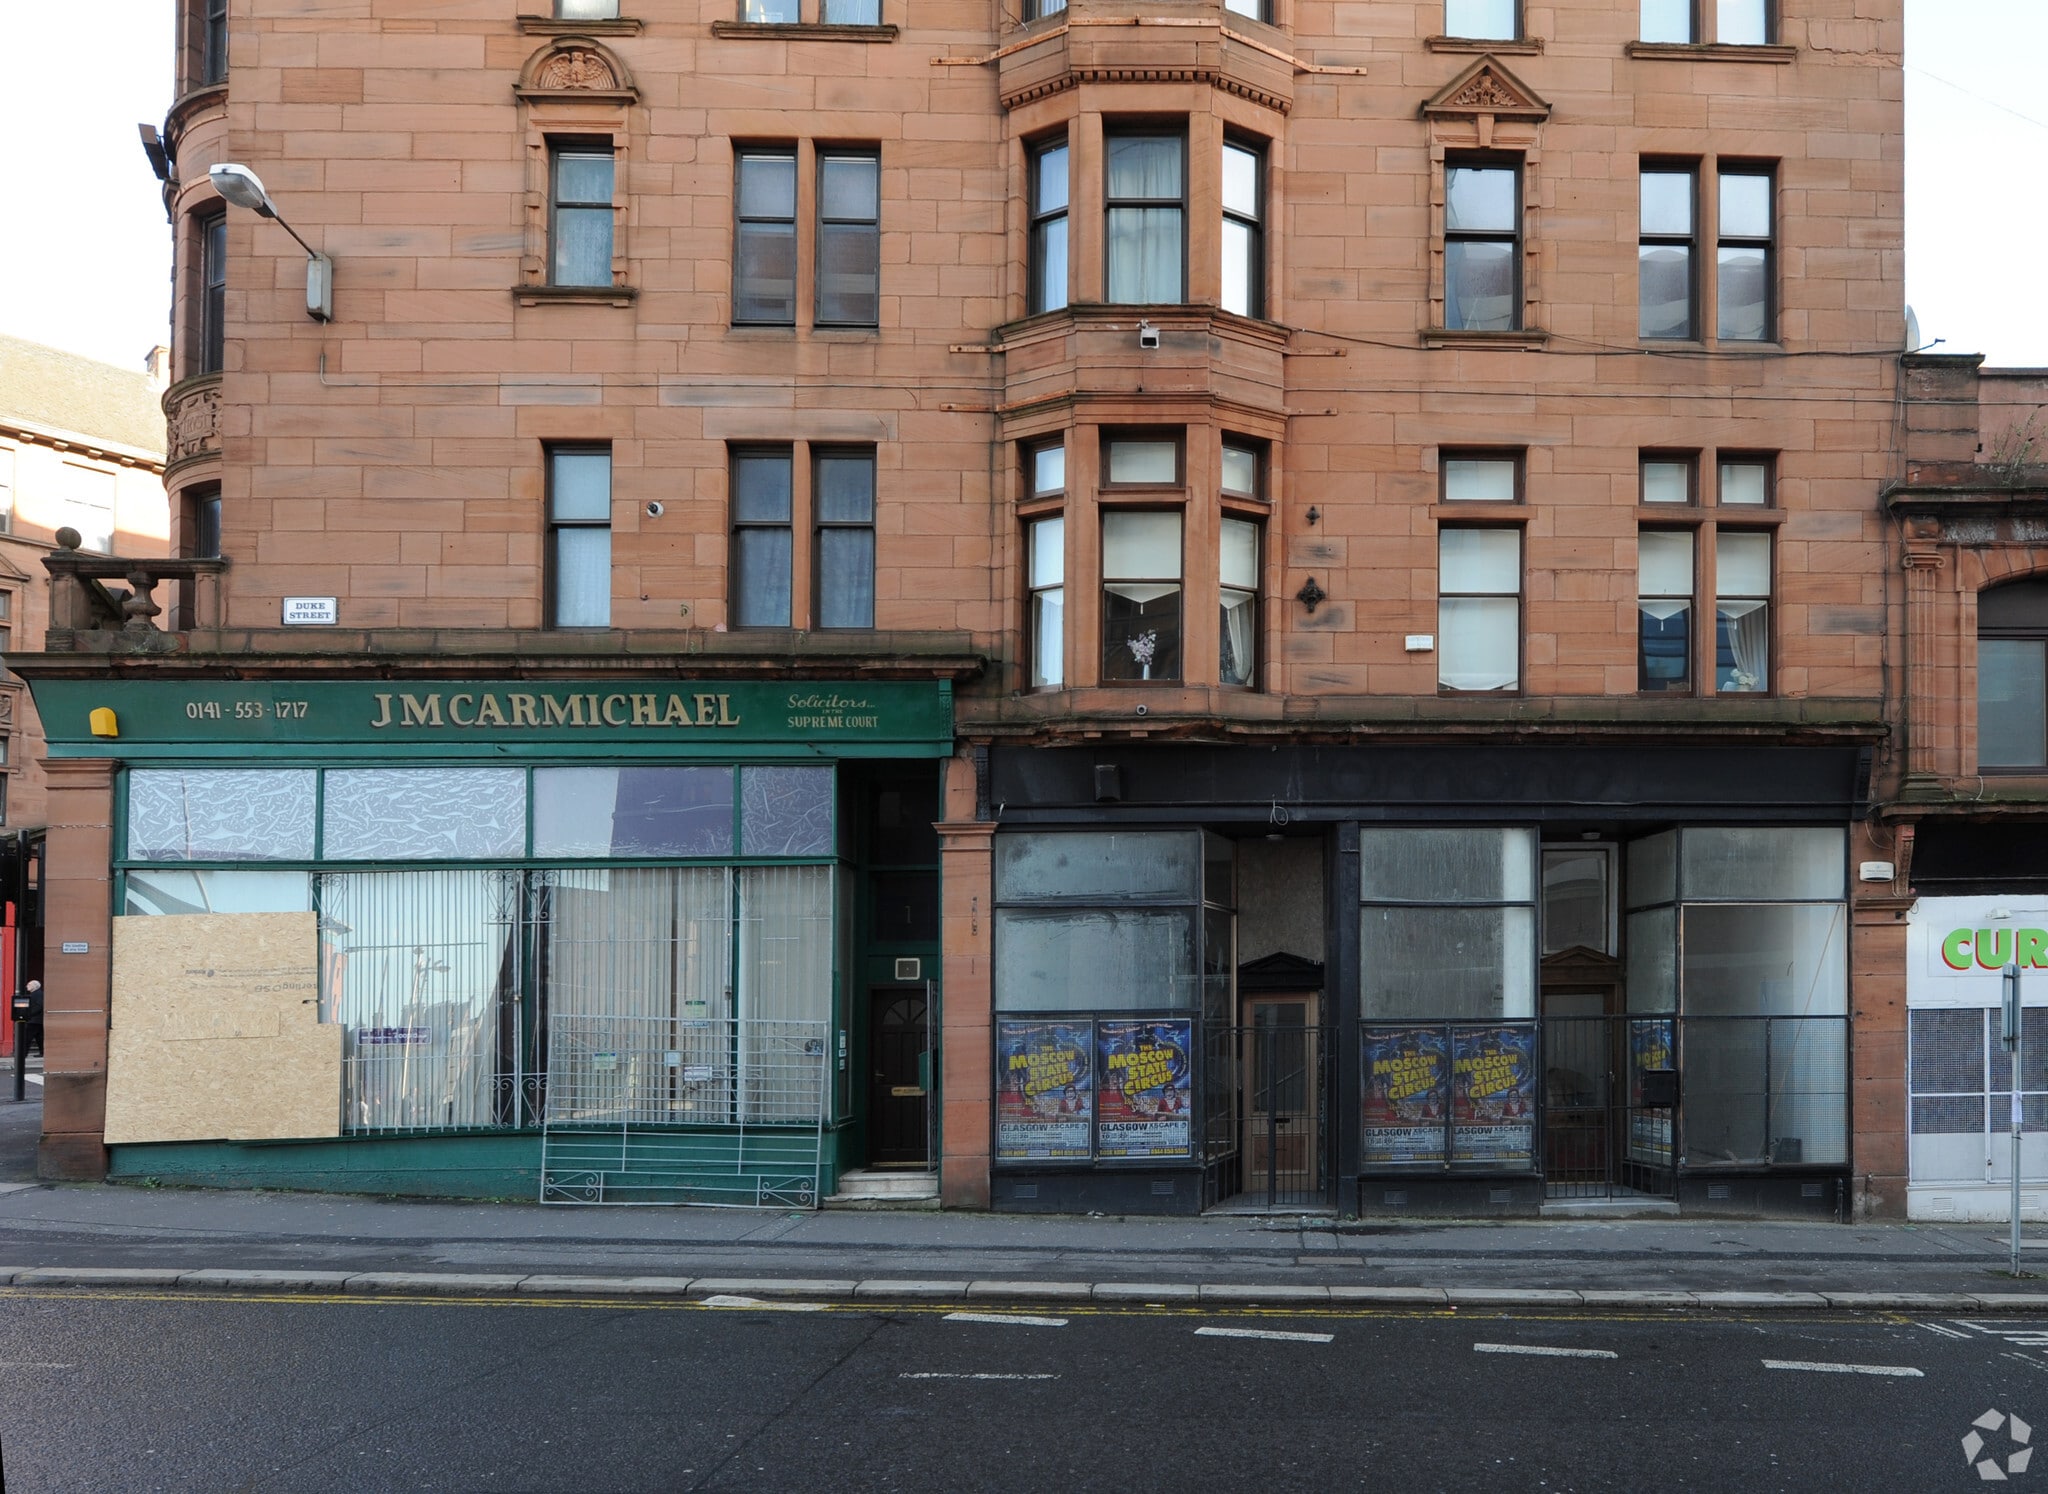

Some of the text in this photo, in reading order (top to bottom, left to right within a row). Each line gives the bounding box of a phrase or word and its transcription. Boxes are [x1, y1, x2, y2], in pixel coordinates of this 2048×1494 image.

[186, 702, 221, 718] 0141
[235, 702, 263, 718] 553
[275, 702, 308, 718] 1717
[787, 716, 878, 728] SUPREME COURT
[1009, 1050, 1075, 1070] MOSCOW
[1108, 1049, 1174, 1069] MOSCOW
[1373, 1055, 1437, 1075] MOSCOW
[1455, 1054, 1517, 1073] MOSCOW
[1030, 1062, 1069, 1080] STATE
[1128, 1061, 1167, 1079] STATE
[1393, 1067, 1430, 1086] STATE
[1474, 1066, 1511, 1084] STATE
[1025, 1072, 1074, 1096] CIRCUS
[1124, 1071, 1173, 1095] CIRCUS
[1388, 1076, 1436, 1099] CIRCUS
[1470, 1075, 1517, 1098] CIRCUS
[1000, 1124, 1048, 1132] GLASGOW
[1100, 1123, 1148, 1131] GLASGOW
[1366, 1128, 1412, 1136] GLASGOW
[1454, 1126, 1493, 1135] LASGOW
